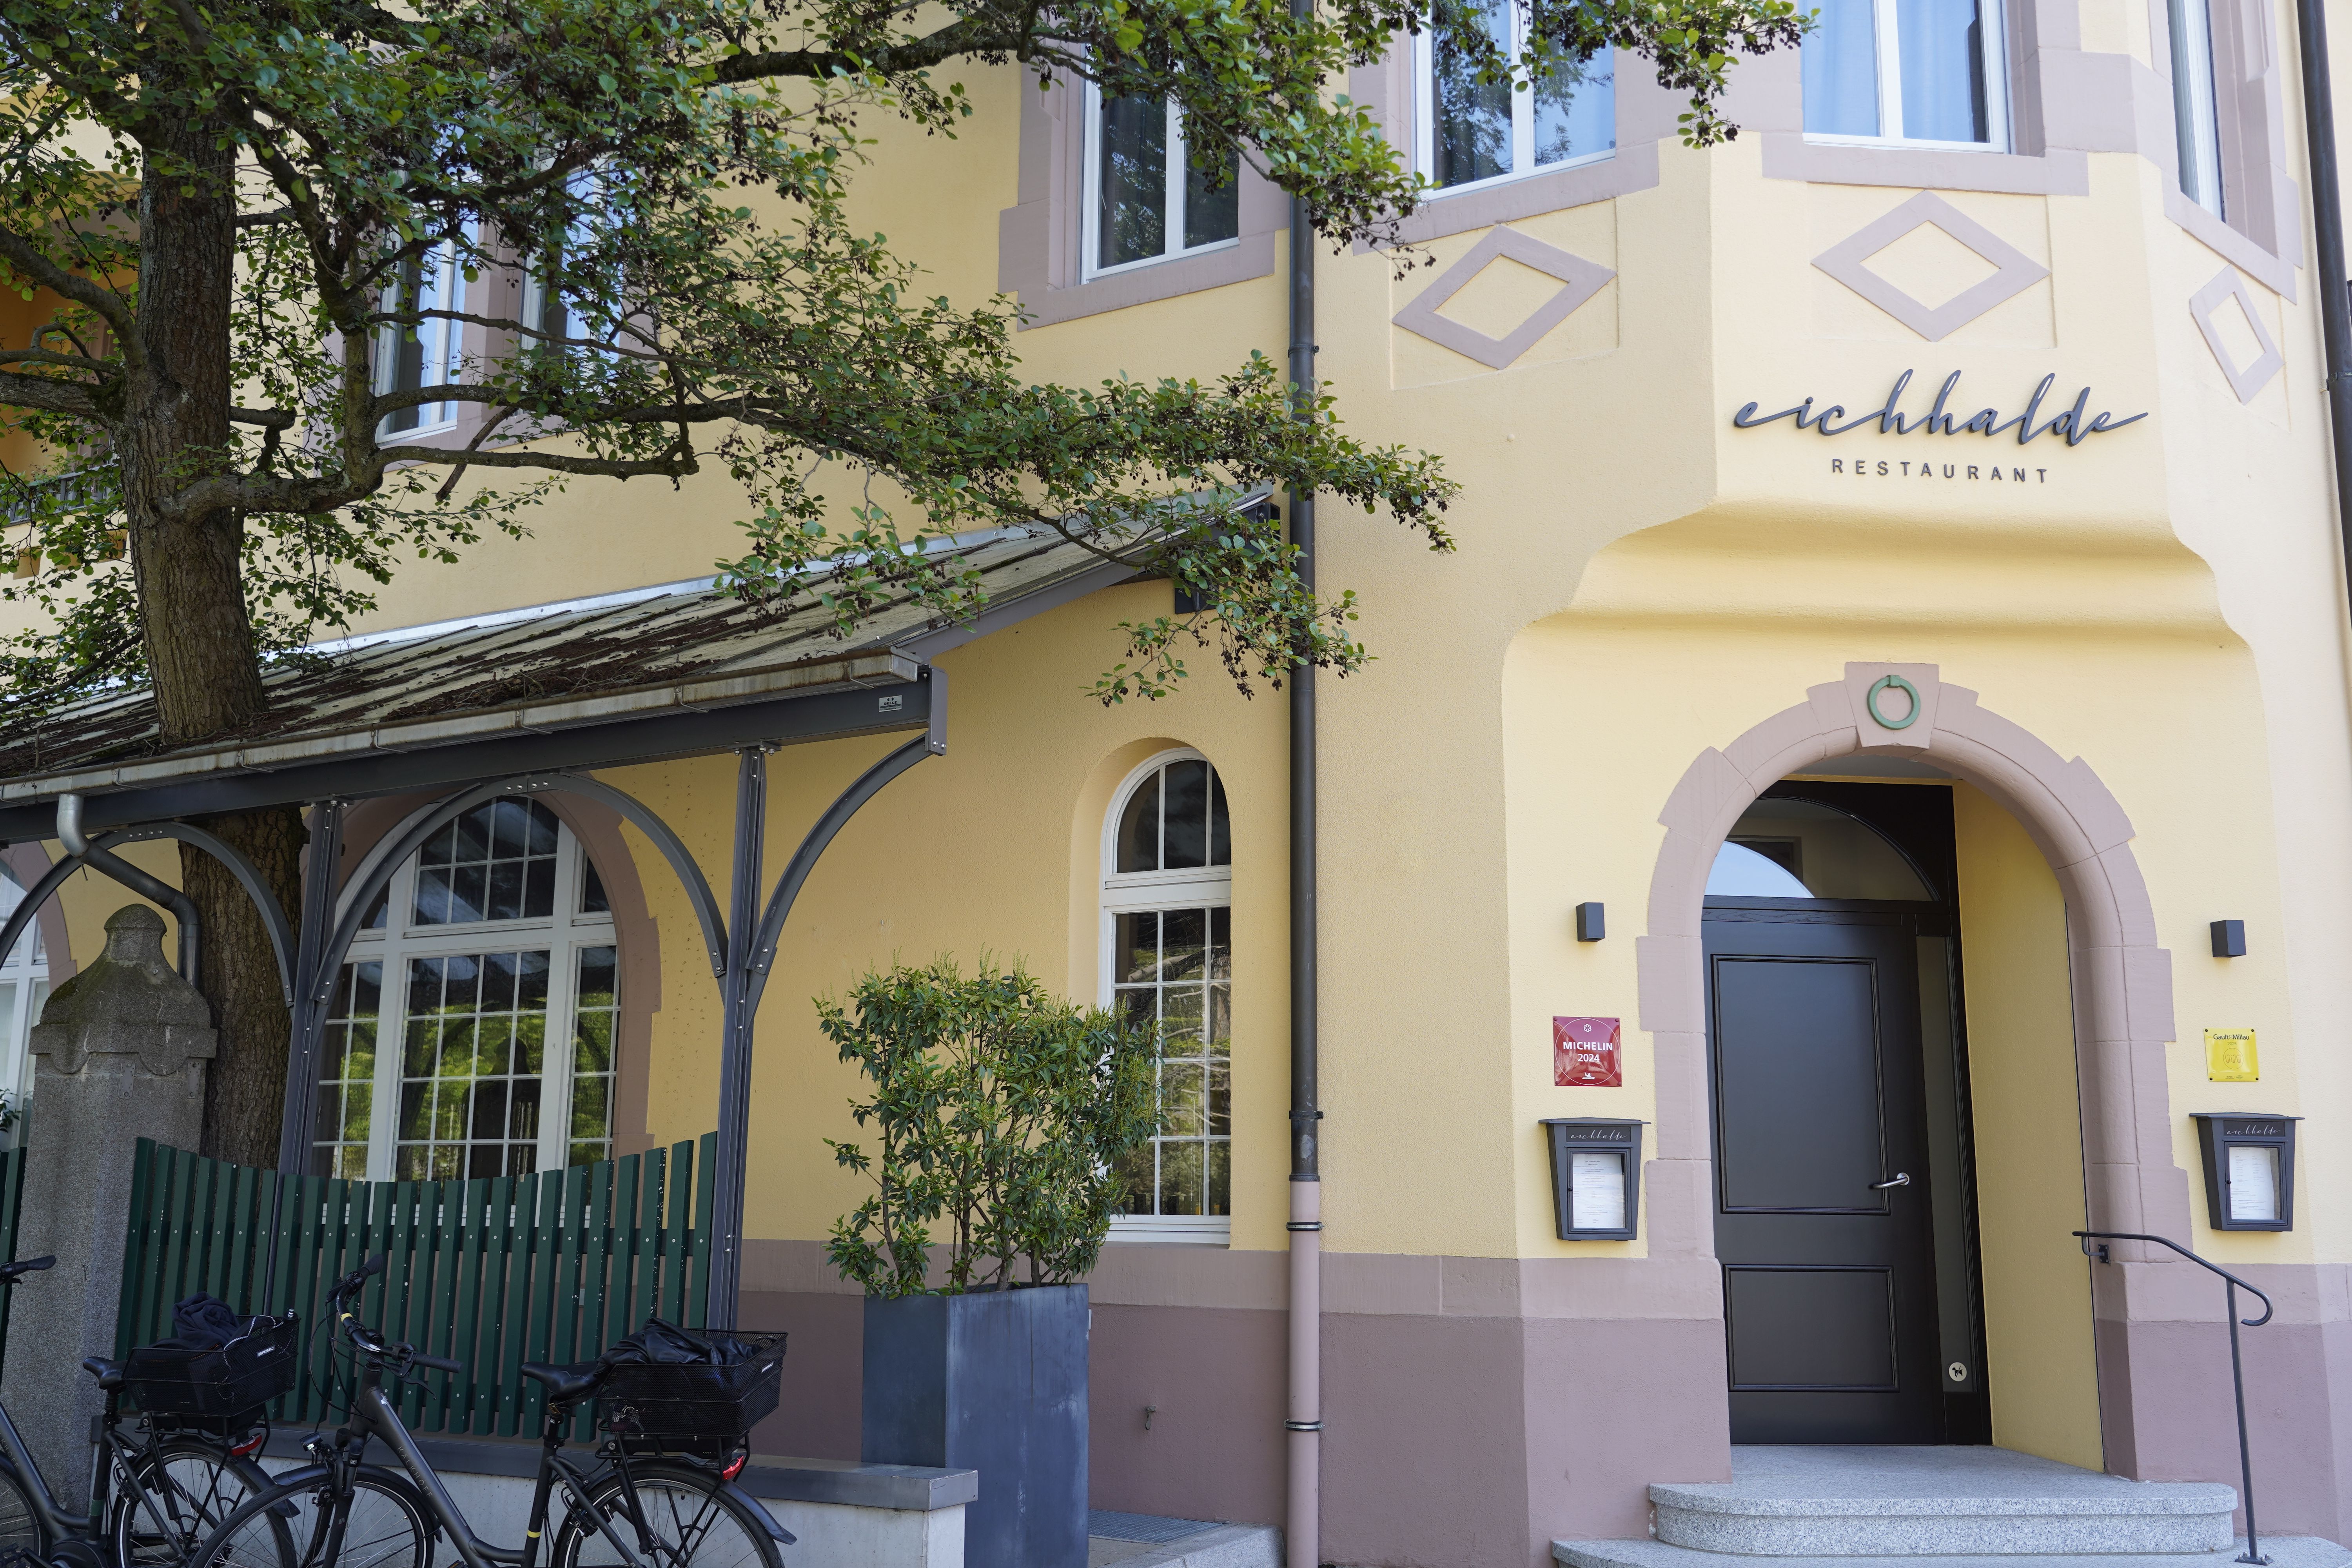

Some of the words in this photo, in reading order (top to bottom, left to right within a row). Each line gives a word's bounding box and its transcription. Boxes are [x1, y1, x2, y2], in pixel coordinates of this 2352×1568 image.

[1734, 368, 2149, 447] eichhalde
[1832, 458, 2047, 483] RESTAURANT
[1563, 1041, 1613, 1051] MICHELIN
[1577, 1053, 1600, 1062] 2024
[1570, 1129, 1628, 1140] eichhalde
[2227, 1124, 2281, 1135] eichhalde
[0, 1432, 19, 1468] KHOFF
[397, 1446, 433, 1497] KALKHOFF
